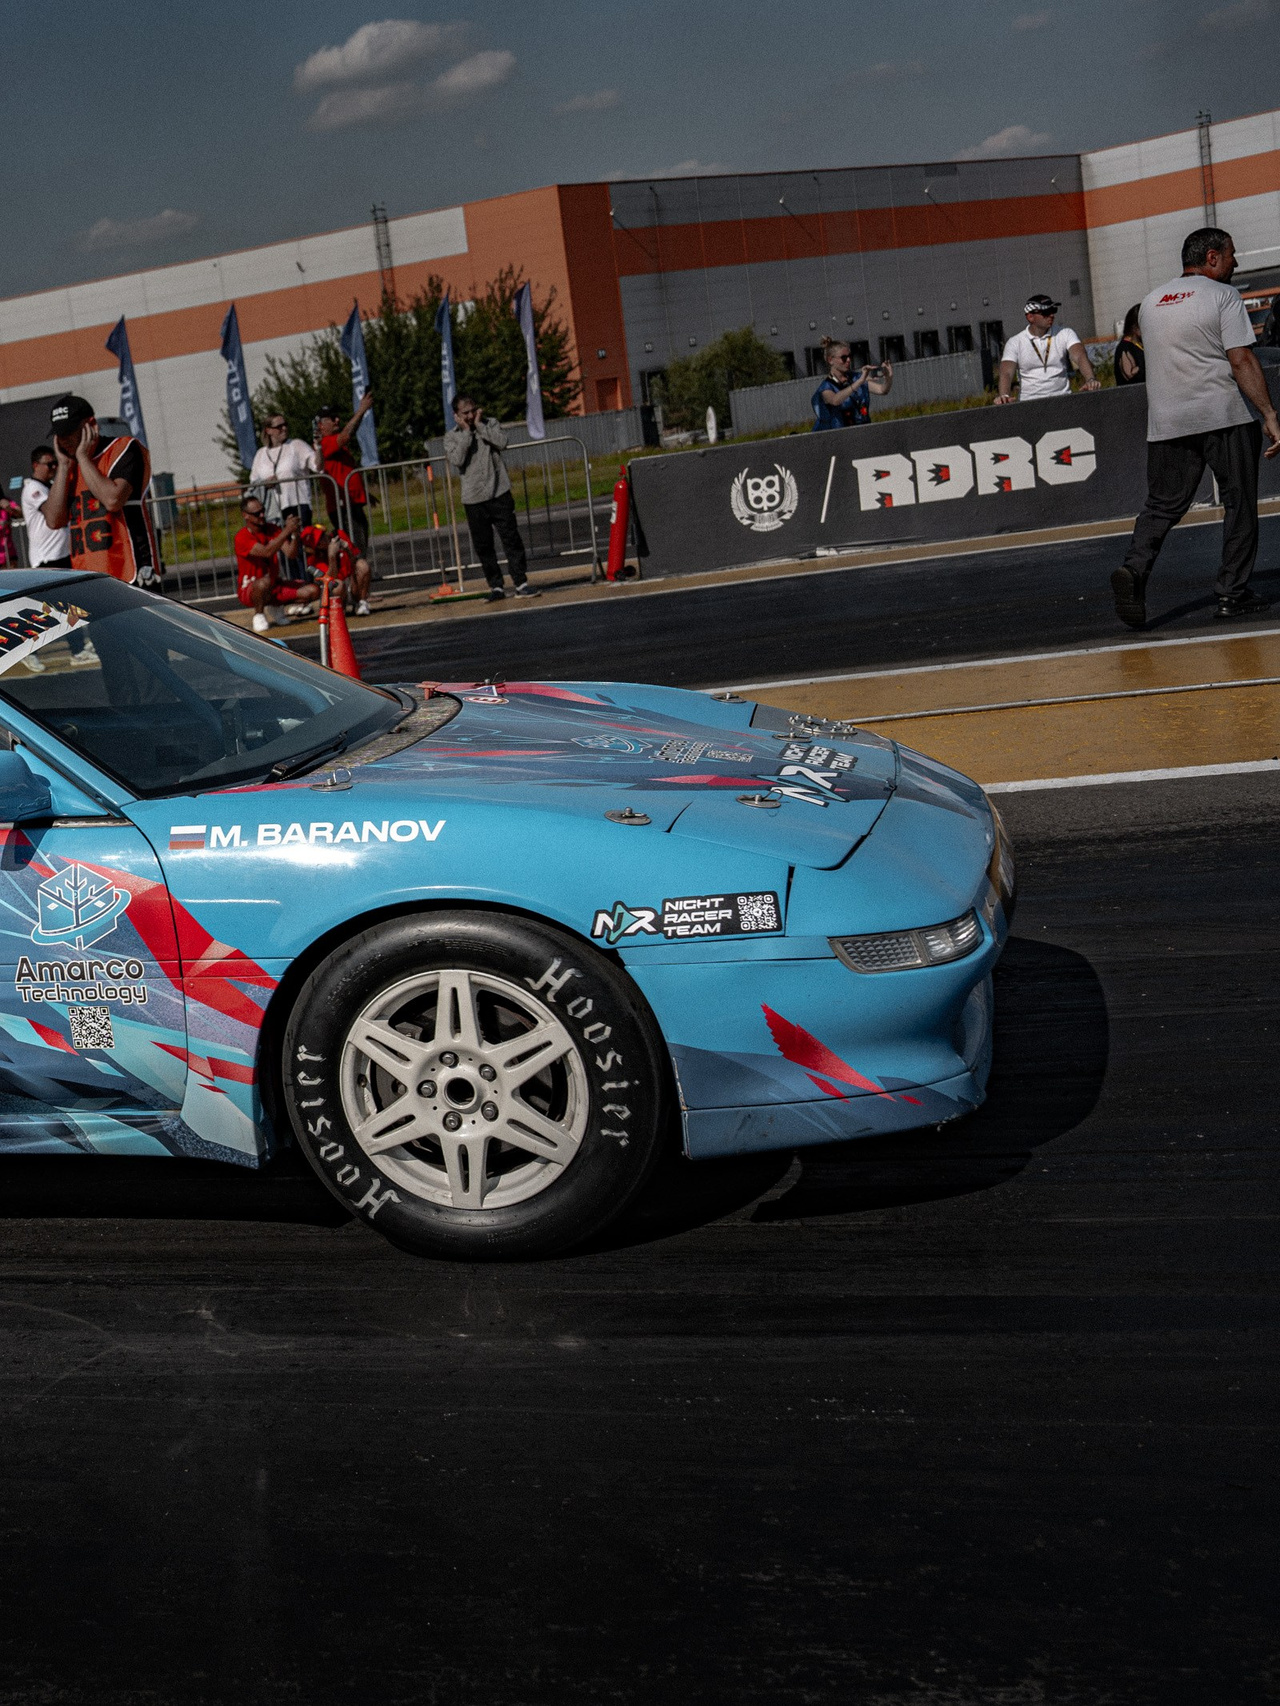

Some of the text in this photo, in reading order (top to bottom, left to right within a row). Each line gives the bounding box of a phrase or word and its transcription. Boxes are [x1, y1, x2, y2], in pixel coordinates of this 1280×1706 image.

[851, 427, 1097, 512] RDRC
[210, 820, 446, 848] M. BARANOV
[664, 909, 732, 924] RACER
[665, 898, 724, 912] NIGHT
[664, 922, 721, 937] TEAM
[15, 956, 144, 983] Amarco
[15, 982, 148, 1005] Technology
[524, 957, 641, 1148] Hoosier
[296, 1044, 402, 1220] Hoosier
